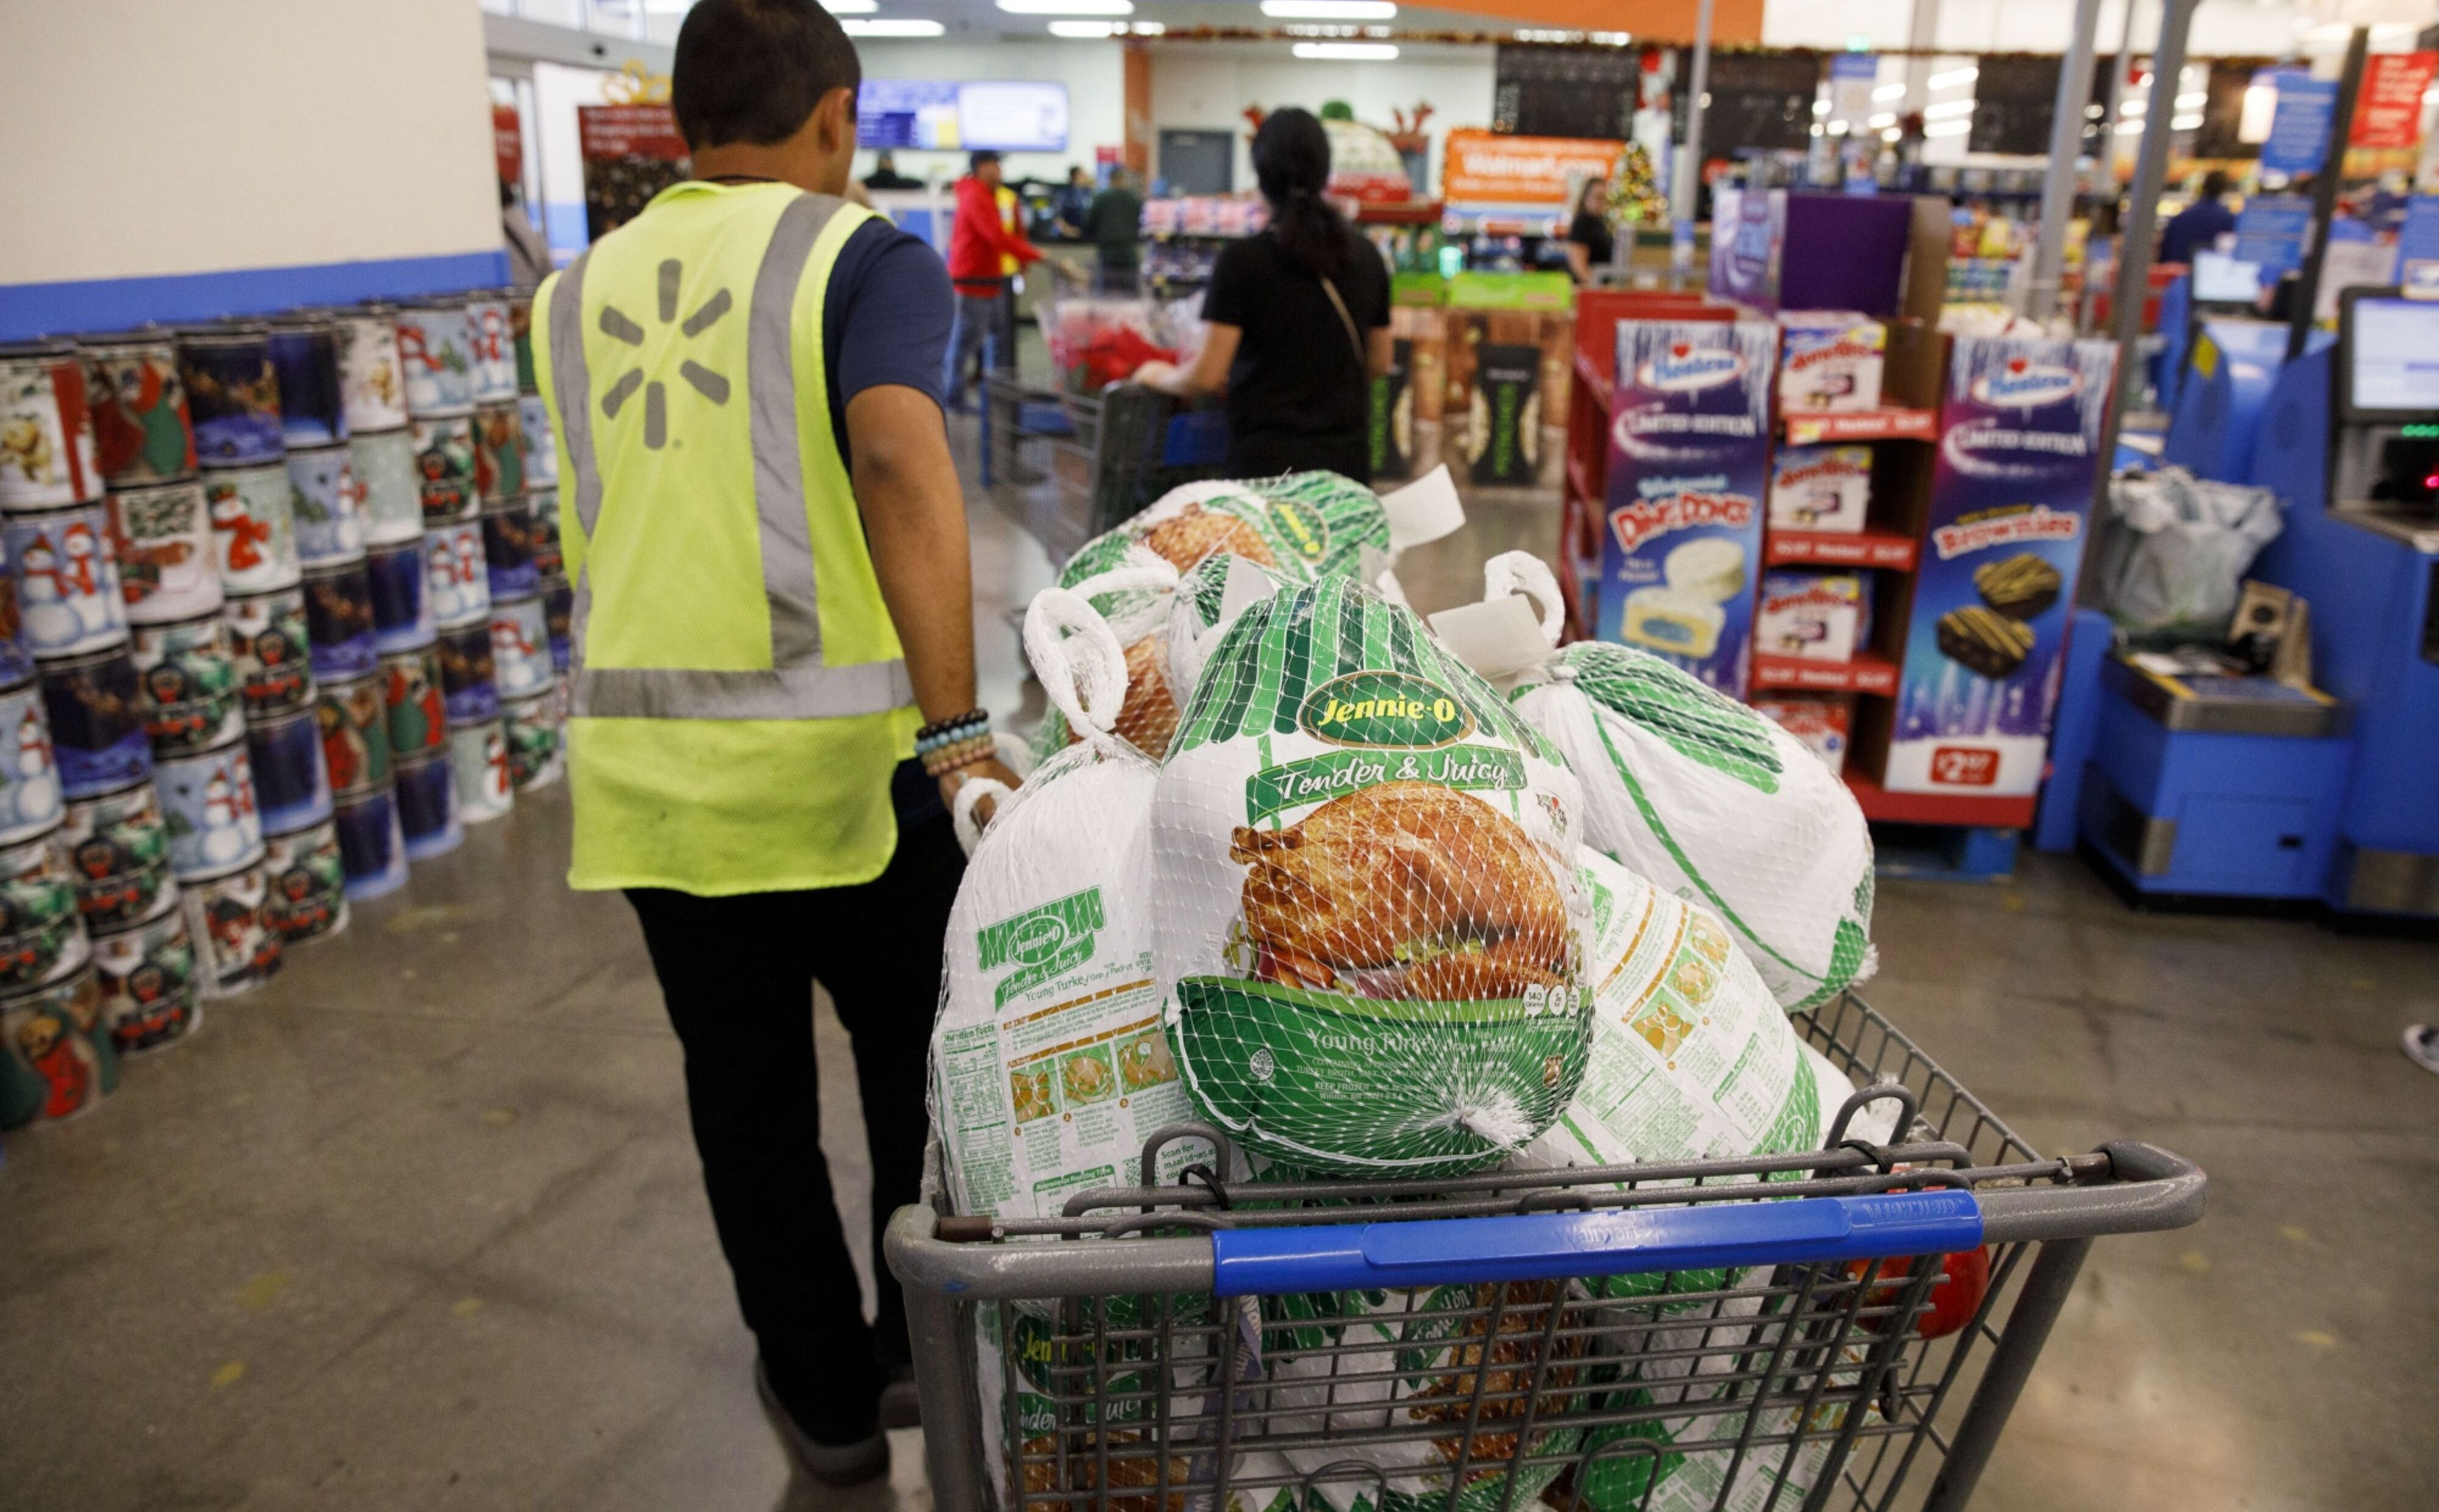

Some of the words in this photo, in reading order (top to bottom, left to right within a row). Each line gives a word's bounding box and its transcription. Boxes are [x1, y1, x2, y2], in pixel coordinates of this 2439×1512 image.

[1273, 758, 1385, 799] Tender
[1395, 756, 1420, 779] &
[1428, 753, 1507, 790] Juicy
[1049, 950, 1083, 974] Juicy
[1055, 974, 1090, 992] Turkey
[1307, 1028, 1375, 1056] Young
[1379, 1032, 1437, 1058] Turkey
[1315, 1081, 1335, 1090] KEEP
[1338, 1081, 1370, 1091] FROZEN
[1161, 1148, 1181, 1159] Scan
[1182, 1144, 1194, 1152] for
